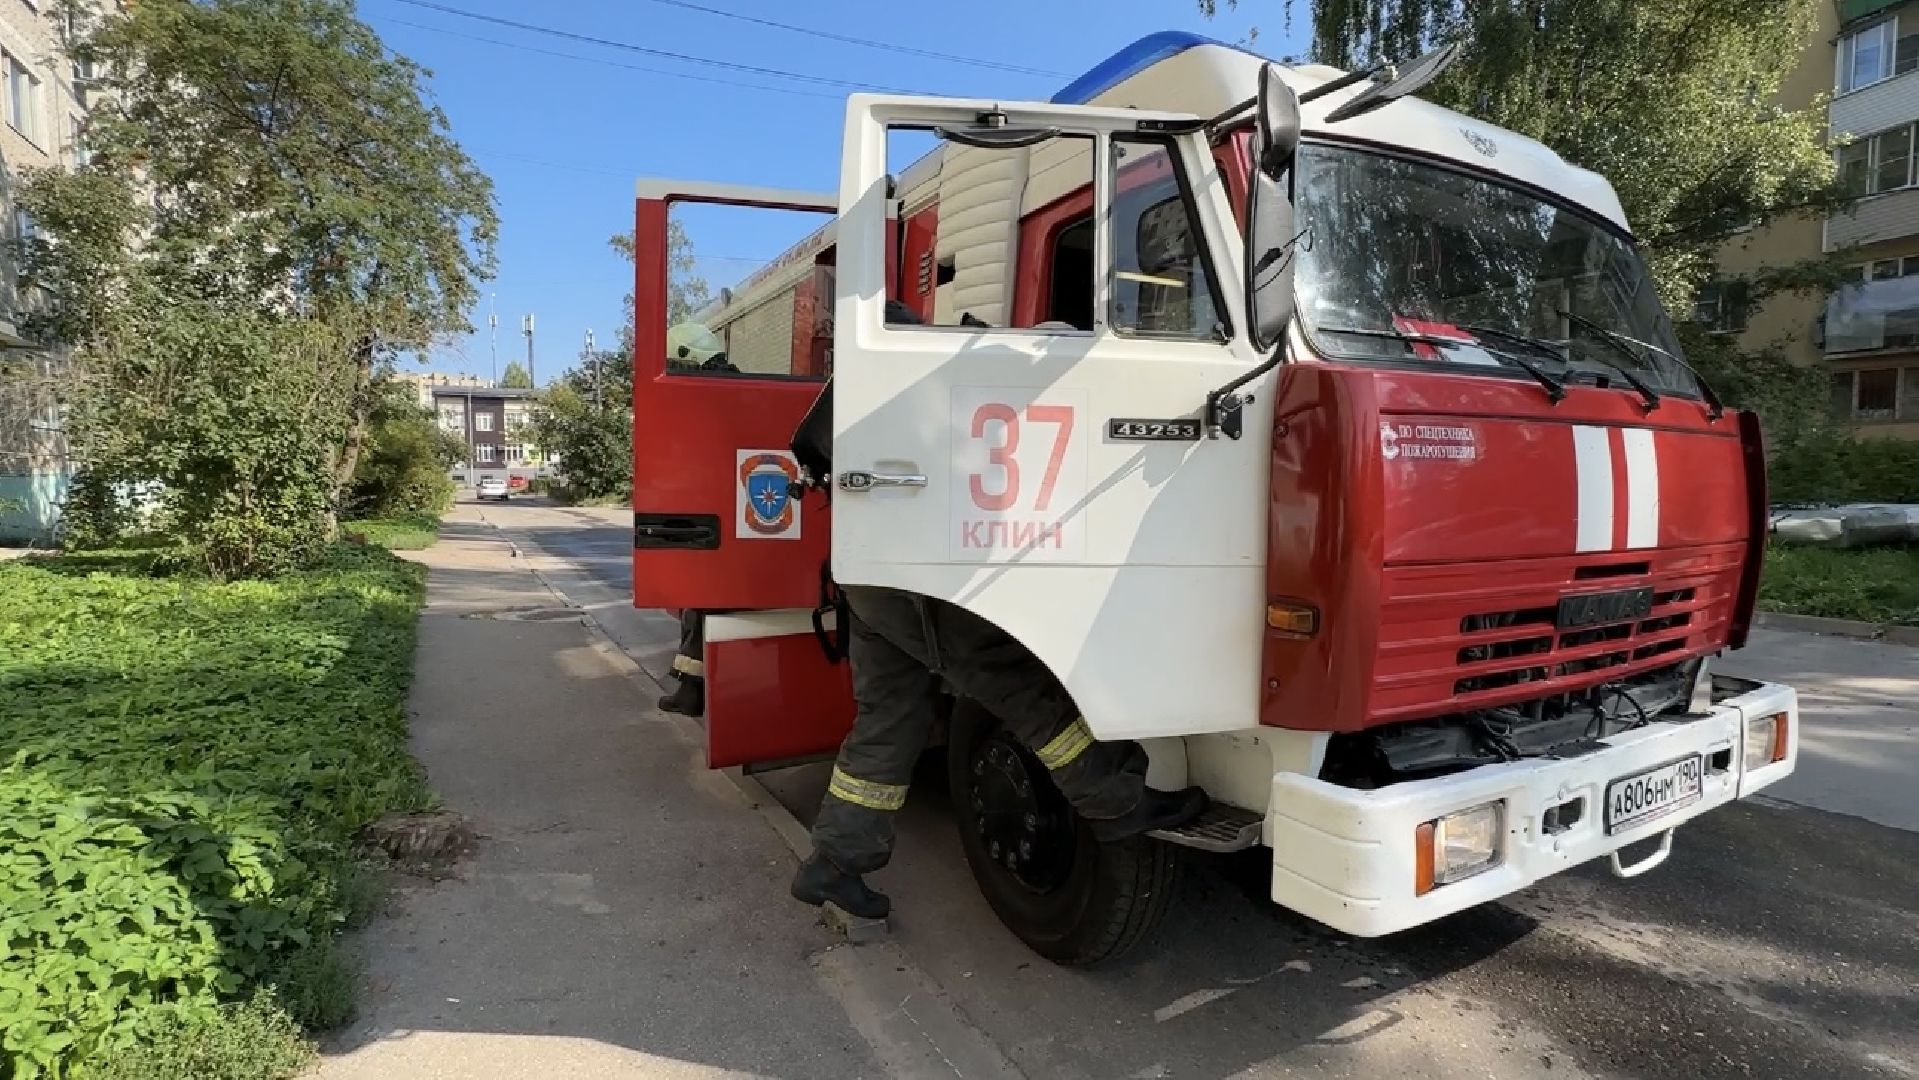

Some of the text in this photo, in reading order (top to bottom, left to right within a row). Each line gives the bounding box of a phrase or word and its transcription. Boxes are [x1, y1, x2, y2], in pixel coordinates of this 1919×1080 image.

[1116, 422, 1195, 438] 43253
[968, 403, 1075, 512] 37
[962, 520, 1063, 549] КЛИН
